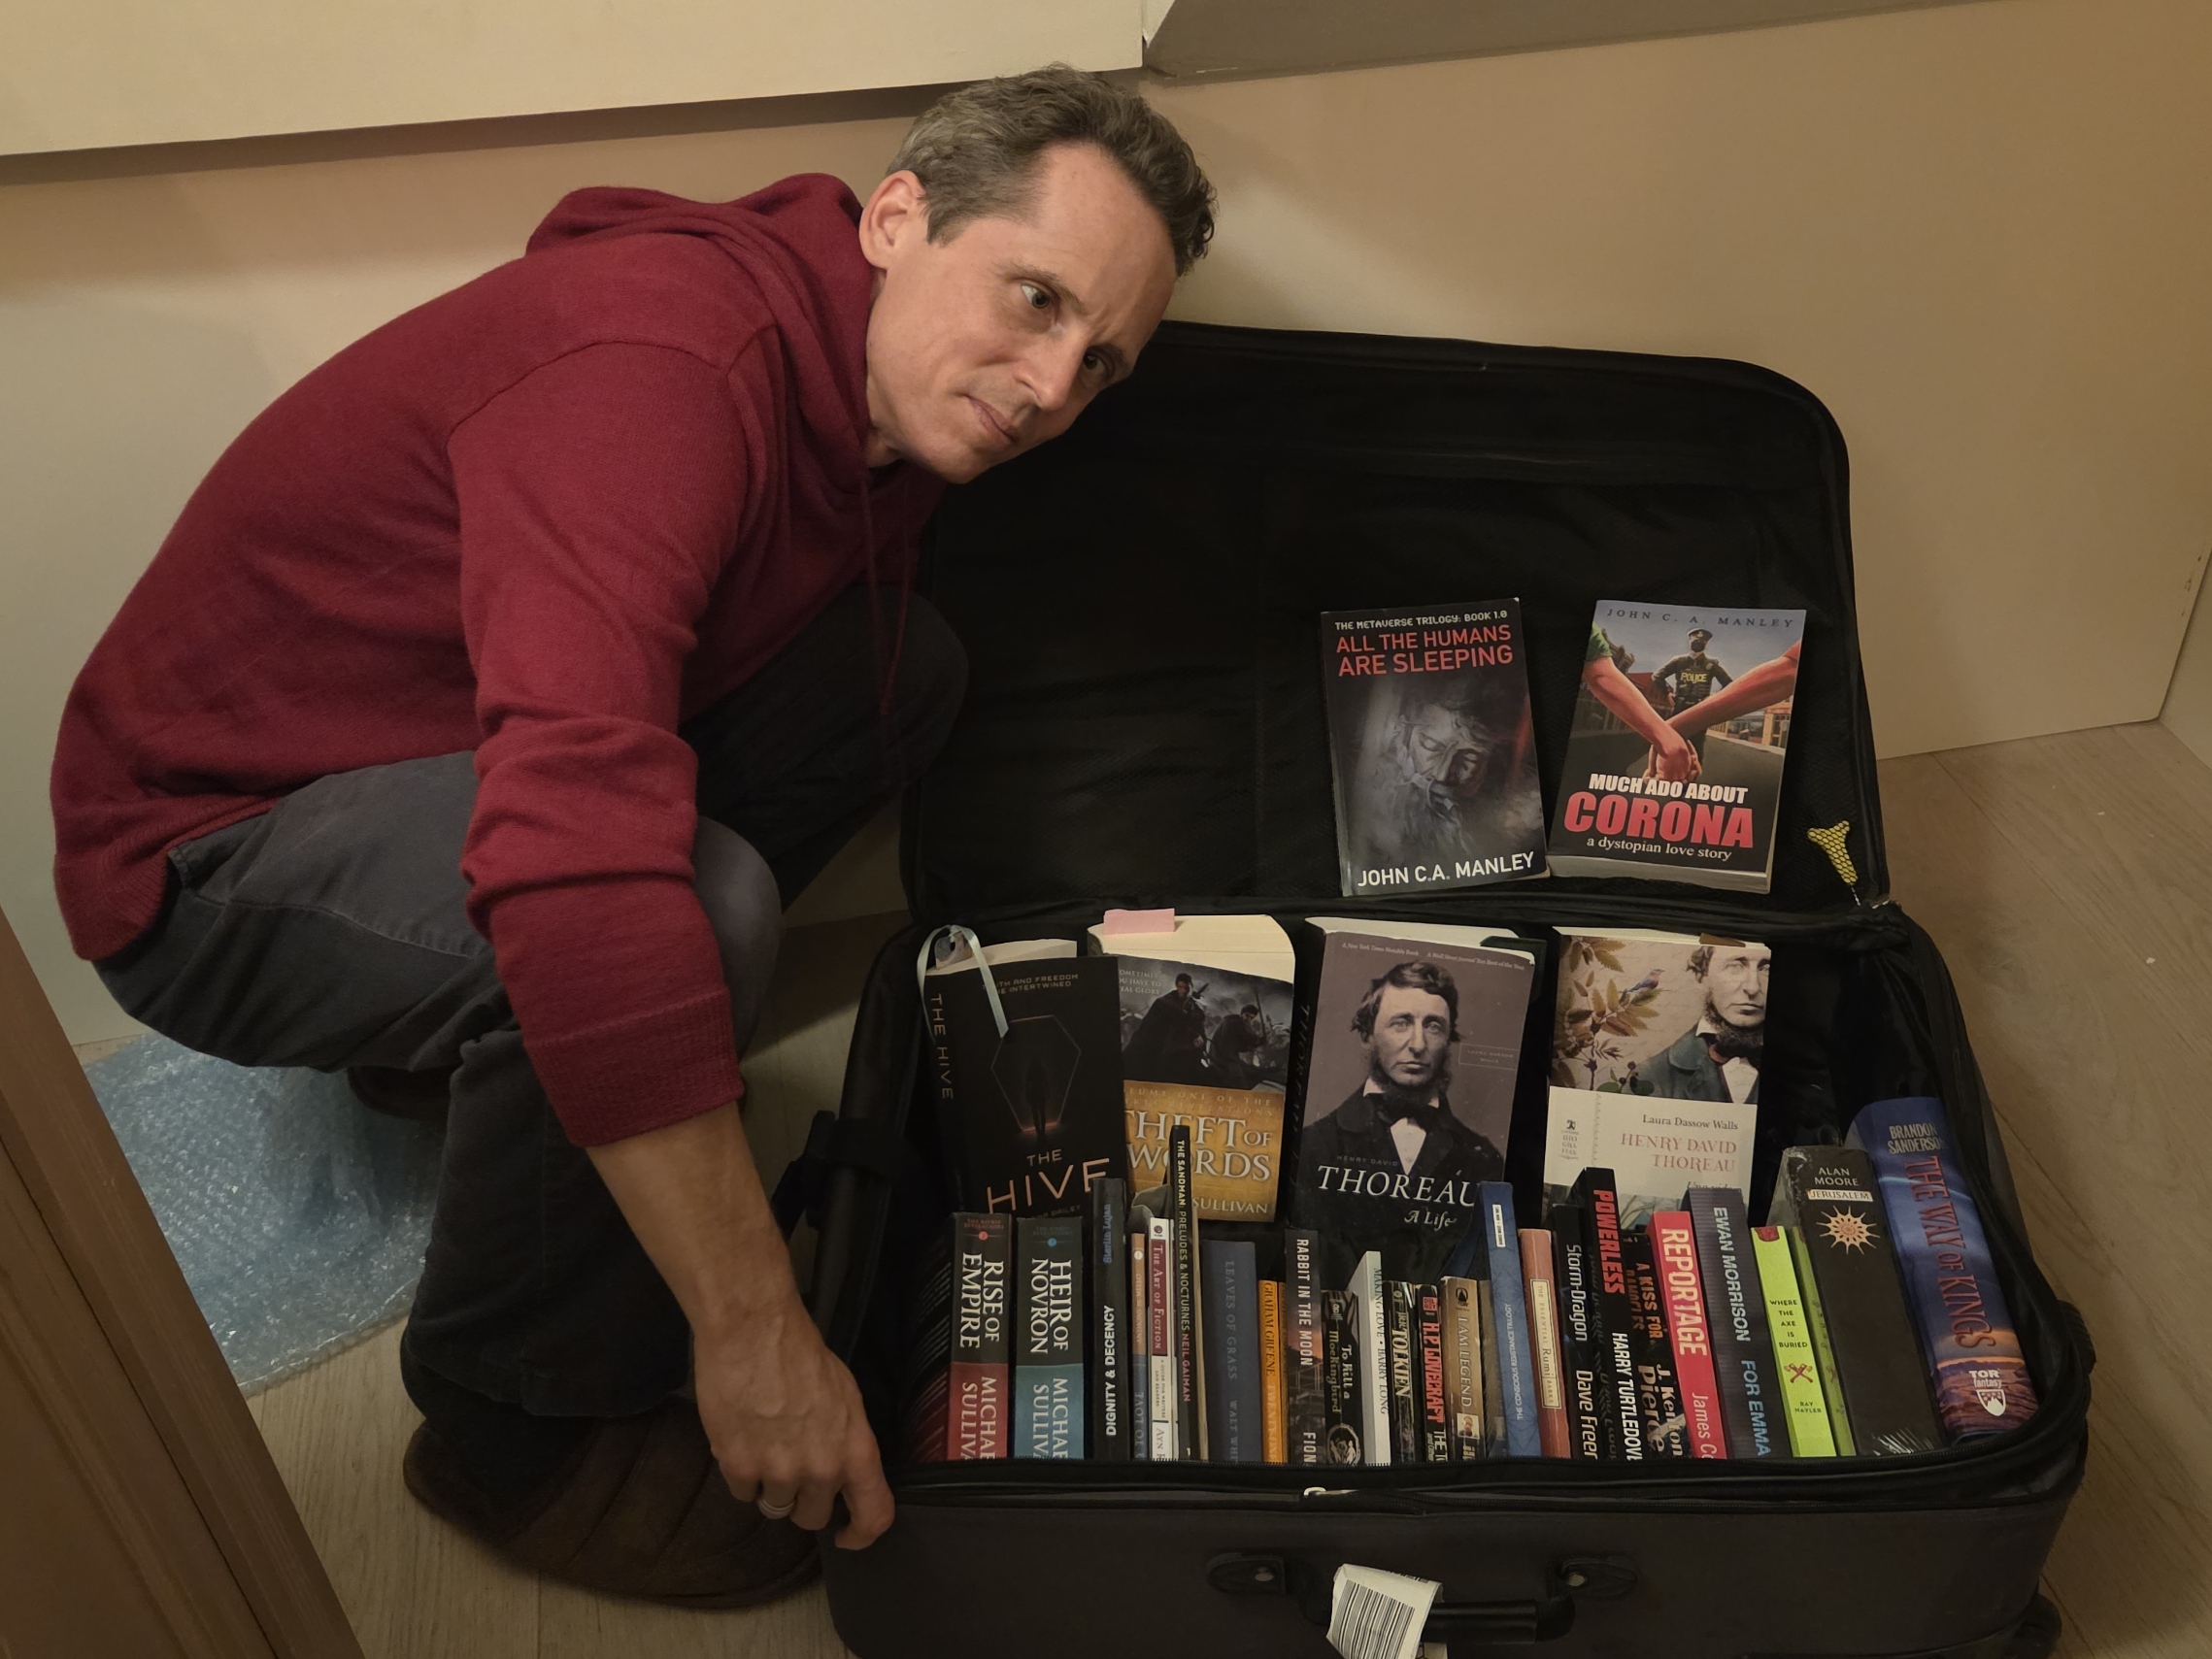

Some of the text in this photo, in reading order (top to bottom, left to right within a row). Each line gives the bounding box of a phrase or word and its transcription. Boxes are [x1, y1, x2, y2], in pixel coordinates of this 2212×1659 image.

[1335, 621, 1354, 631] THE
[1357, 617, 1414, 629] METAVERSE
[1416, 614, 1460, 625] TRILOGY:
[1464, 612, 1491, 621] BOOK
[1606, 608, 1794, 629] JOHN C. A. MANLEY
[1336, 623, 1512, 653] ALL THE HUMANS
[1338, 645, 1514, 677] ARE SLEEPING
[1589, 773, 1749, 804] MUCH ADO ABOUT
[1563, 791, 1754, 849] CORONA
[1587, 835, 1732, 862] a dystopian love story
[1357, 850, 1536, 887] JOHN C.A. MANLEY
[1009, 980, 1072, 993] INTERTWINED
[1013, 973, 1079, 985] AND FREEDOM
[930, 992, 954, 1101] THE HIVE
[1244, 1097, 1272, 1107] THE
[1244, 1130, 1273, 1147] OF
[1643, 1114, 1738, 1130] Laura Dassow Walls
[1888, 1126, 1938, 1140] BRANDON
[1026, 1149, 1062, 1167] THE
[1177, 1140, 1186, 1159] THE
[1621, 1133, 1737, 1155] HENRY DAVID
[1888, 1136, 1946, 1155] SANDERSON
[1652, 1153, 1735, 1173] THOREAU
[1814, 1177, 1860, 1186] MOORE
[1818, 1167, 1850, 1177] ALAN
[987, 1157, 1111, 1215] HIVE
[1811, 1190, 1870, 1200] JERUSALEM
[1178, 1211, 1189, 1260] PRELUDES
[1403, 1210, 1458, 1231] A Life
[1713, 1207, 1734, 1251] EWAN
[1296, 1239, 1311, 1281] RABBIT
[1904, 1155, 1997, 1349] THE WAY OF KINGS
[1297, 1285, 1311, 1298] IN
[1592, 1188, 1632, 1375] POWERLESS HARRY
[1721, 1254, 1751, 1343] MORRISON
[959, 1252, 983, 1349] EMPIRE
[983, 1260, 1004, 1342] RISE OF
[1029, 1258, 1049, 1353] NOVRON
[1050, 1260, 1072, 1351] HEIR OF
[1179, 1272, 1190, 1332] NOCTURNES
[1298, 1303, 1312, 1326] THE
[1635, 1262, 1664, 1340] A KISS FOR
[1103, 1305, 1115, 1367] DECENCY
[1154, 1309, 1164, 1349] FICTION
[1263, 1281, 1276, 1377] GRAHAM GREENE
[1373, 1268, 1389, 1415] MAKING LOVE BARRY LONG
[1458, 1324, 1470, 1346] AM
[1538, 1303, 1548, 1344] ESSENTIAL
[1660, 1228, 1713, 1439] REPORTAGE James
[1181, 1333, 1190, 1357] NEIL
[1224, 1260, 1238, 1431] LEAVES OF GRASS WALT
[1299, 1330, 1313, 1367] MOON
[1391, 1328, 1411, 1398] TOLKIEN
[1504, 1303, 1525, 1420] THE CONSCIOUS RESISTANCE TRILOGY
[1542, 1347, 1554, 1377] Rumi
[1565, 1244, 1599, 1460] Storm-Dragon Dave Freer
[1181, 1359, 1191, 1402] GAIMAN
[1324, 1330, 1342, 1414] Mockingbird
[1341, 1344, 1354, 1400] To Kill a
[1424, 1347, 1445, 1423] LOVECRAFT
[1458, 1349, 1472, 1408] LEGEND
[1656, 1364, 1671, 1380] J.
[1740, 1359, 1760, 1396] FOR
[1969, 1369, 2000, 1378] TOR
[1973, 1378, 2002, 1389] fantasy
[1105, 1381, 1117, 1437] DIGNITY
[1134, 1392, 1144, 1423] LOVE
[1134, 1429, 1144, 1446] TO
[1156, 1428, 1165, 1449] AYN
[1433, 1431, 1447, 1450] THE
[1747, 1400, 1771, 1456] EMMA
